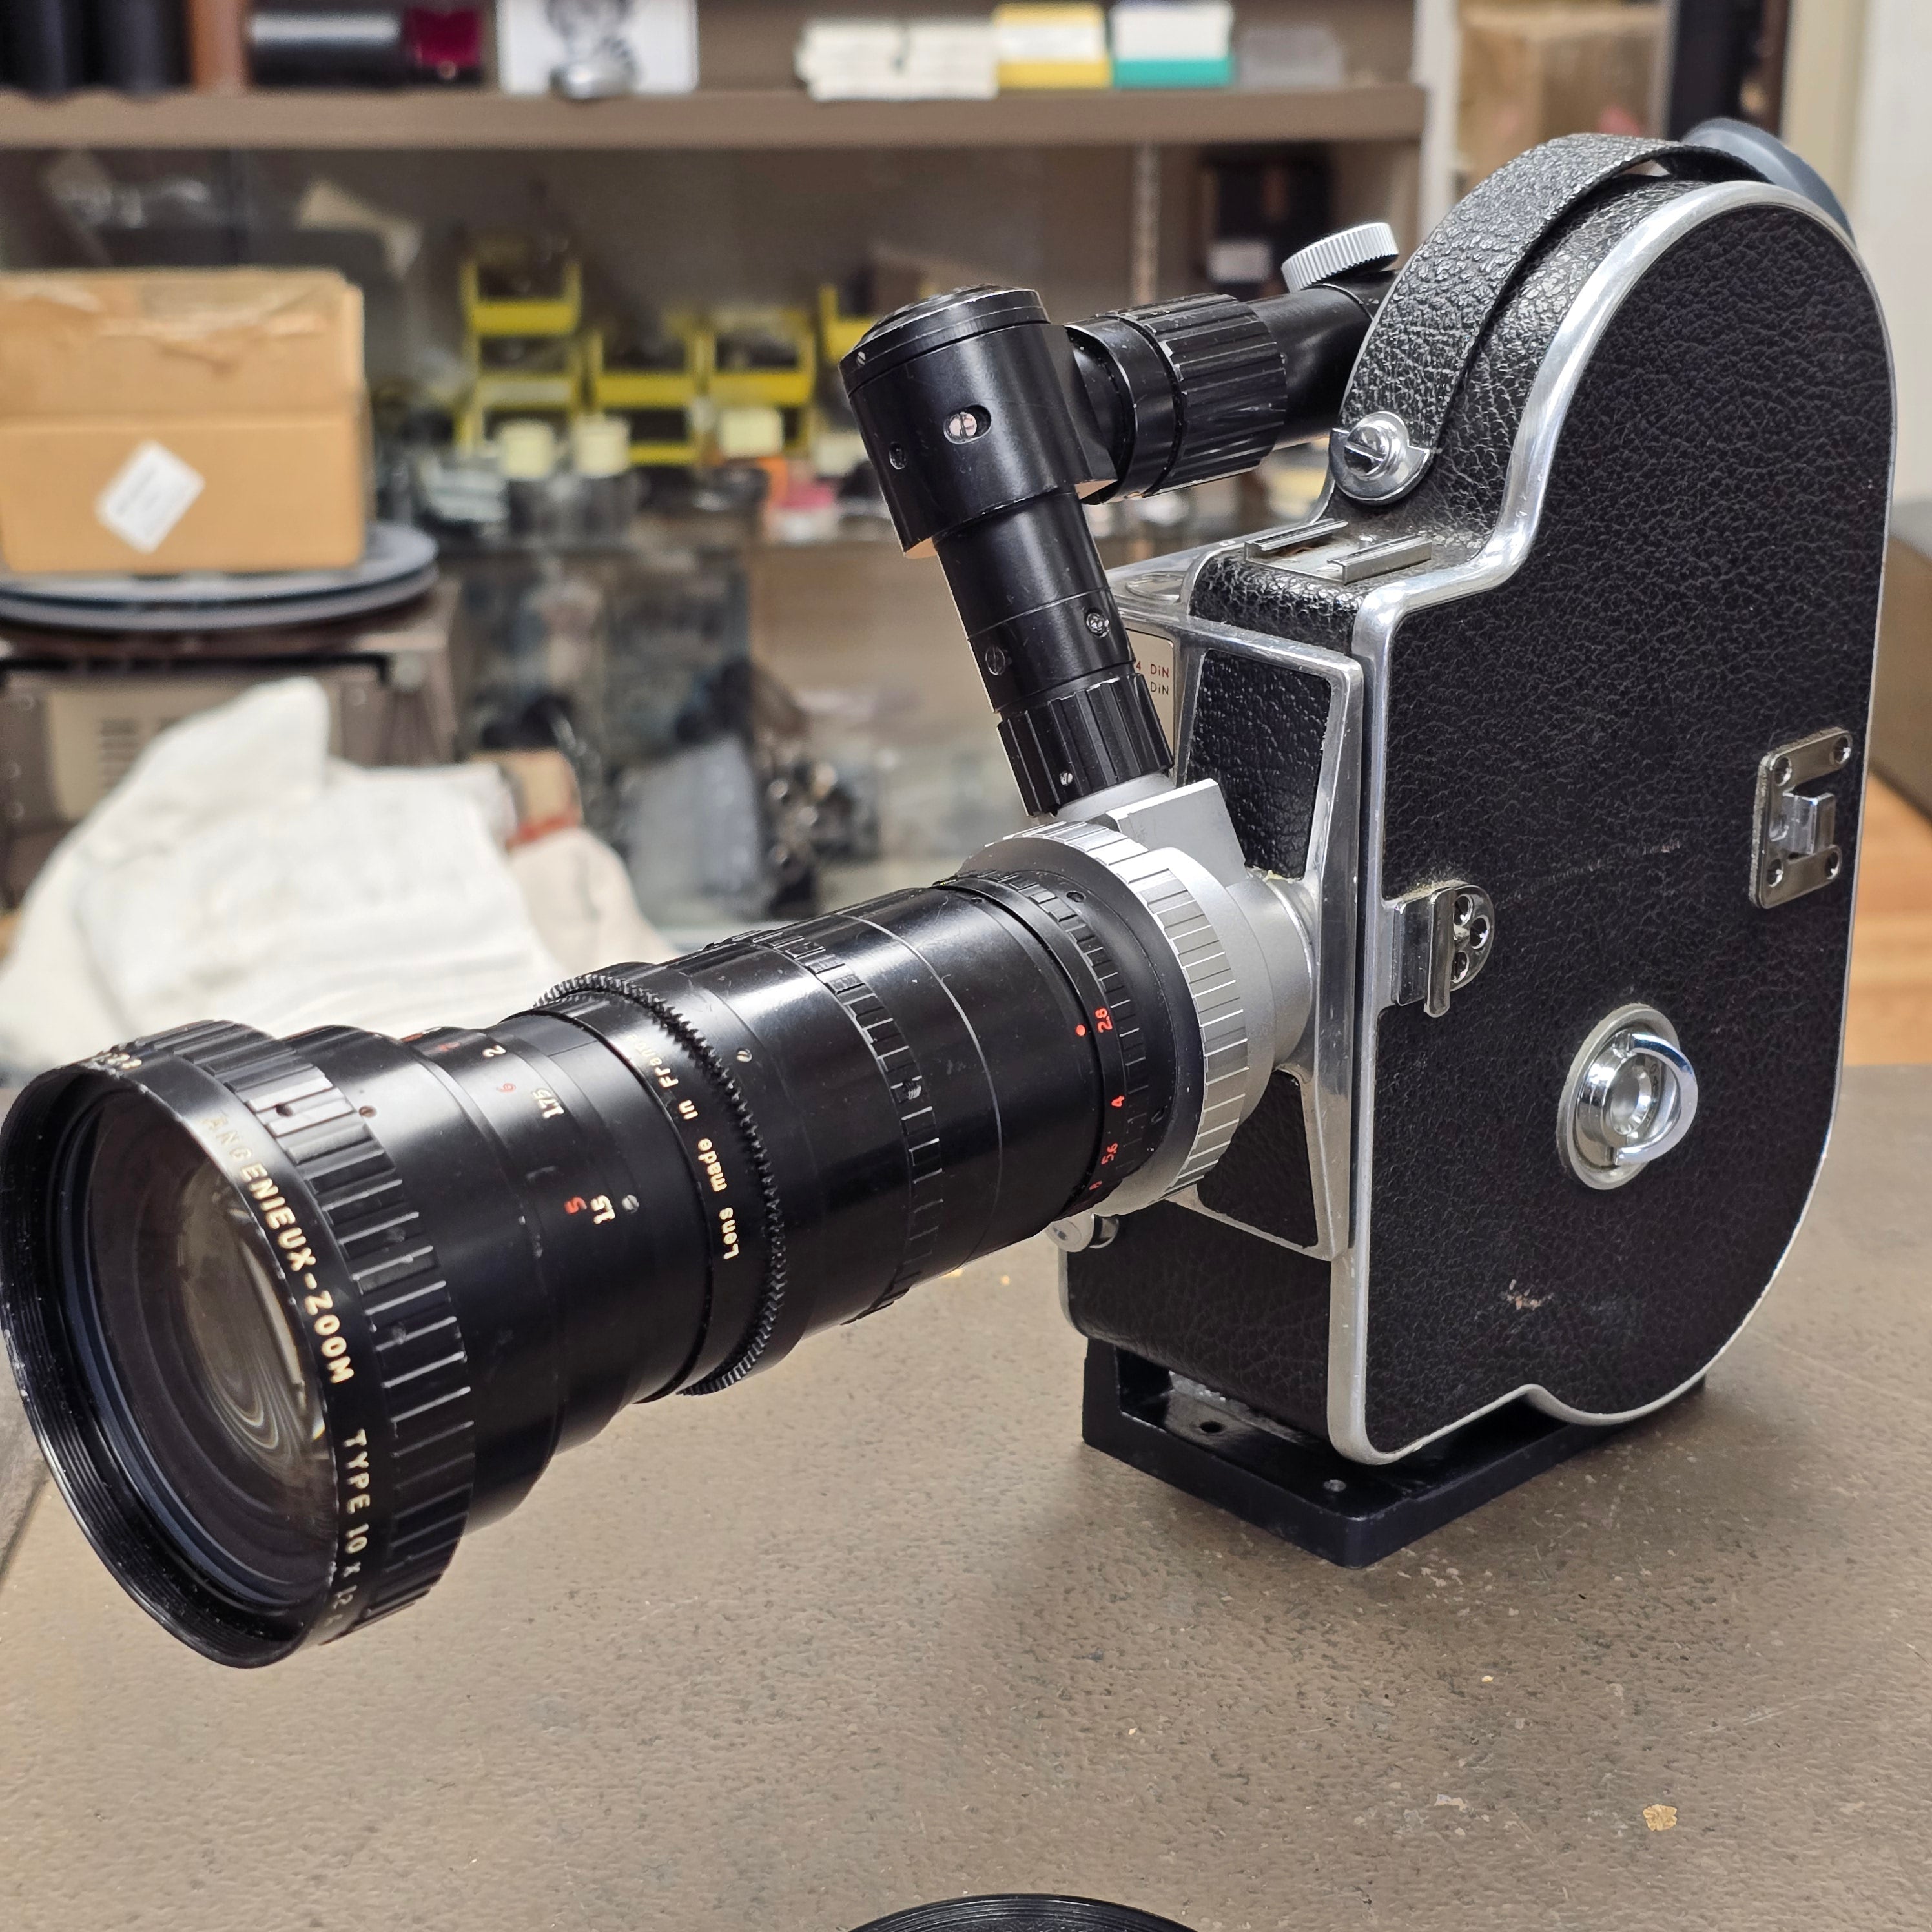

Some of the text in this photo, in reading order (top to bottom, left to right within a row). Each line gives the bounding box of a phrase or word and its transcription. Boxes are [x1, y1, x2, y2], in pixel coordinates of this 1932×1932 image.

[1111, 1095, 1125, 1107] 4
[624, 1033, 739, 1259] Lens made in France
[564, 1196, 587, 1215] 5
[344, 1428, 371, 1514] TYPE
[345, 1523, 370, 1554] 10
